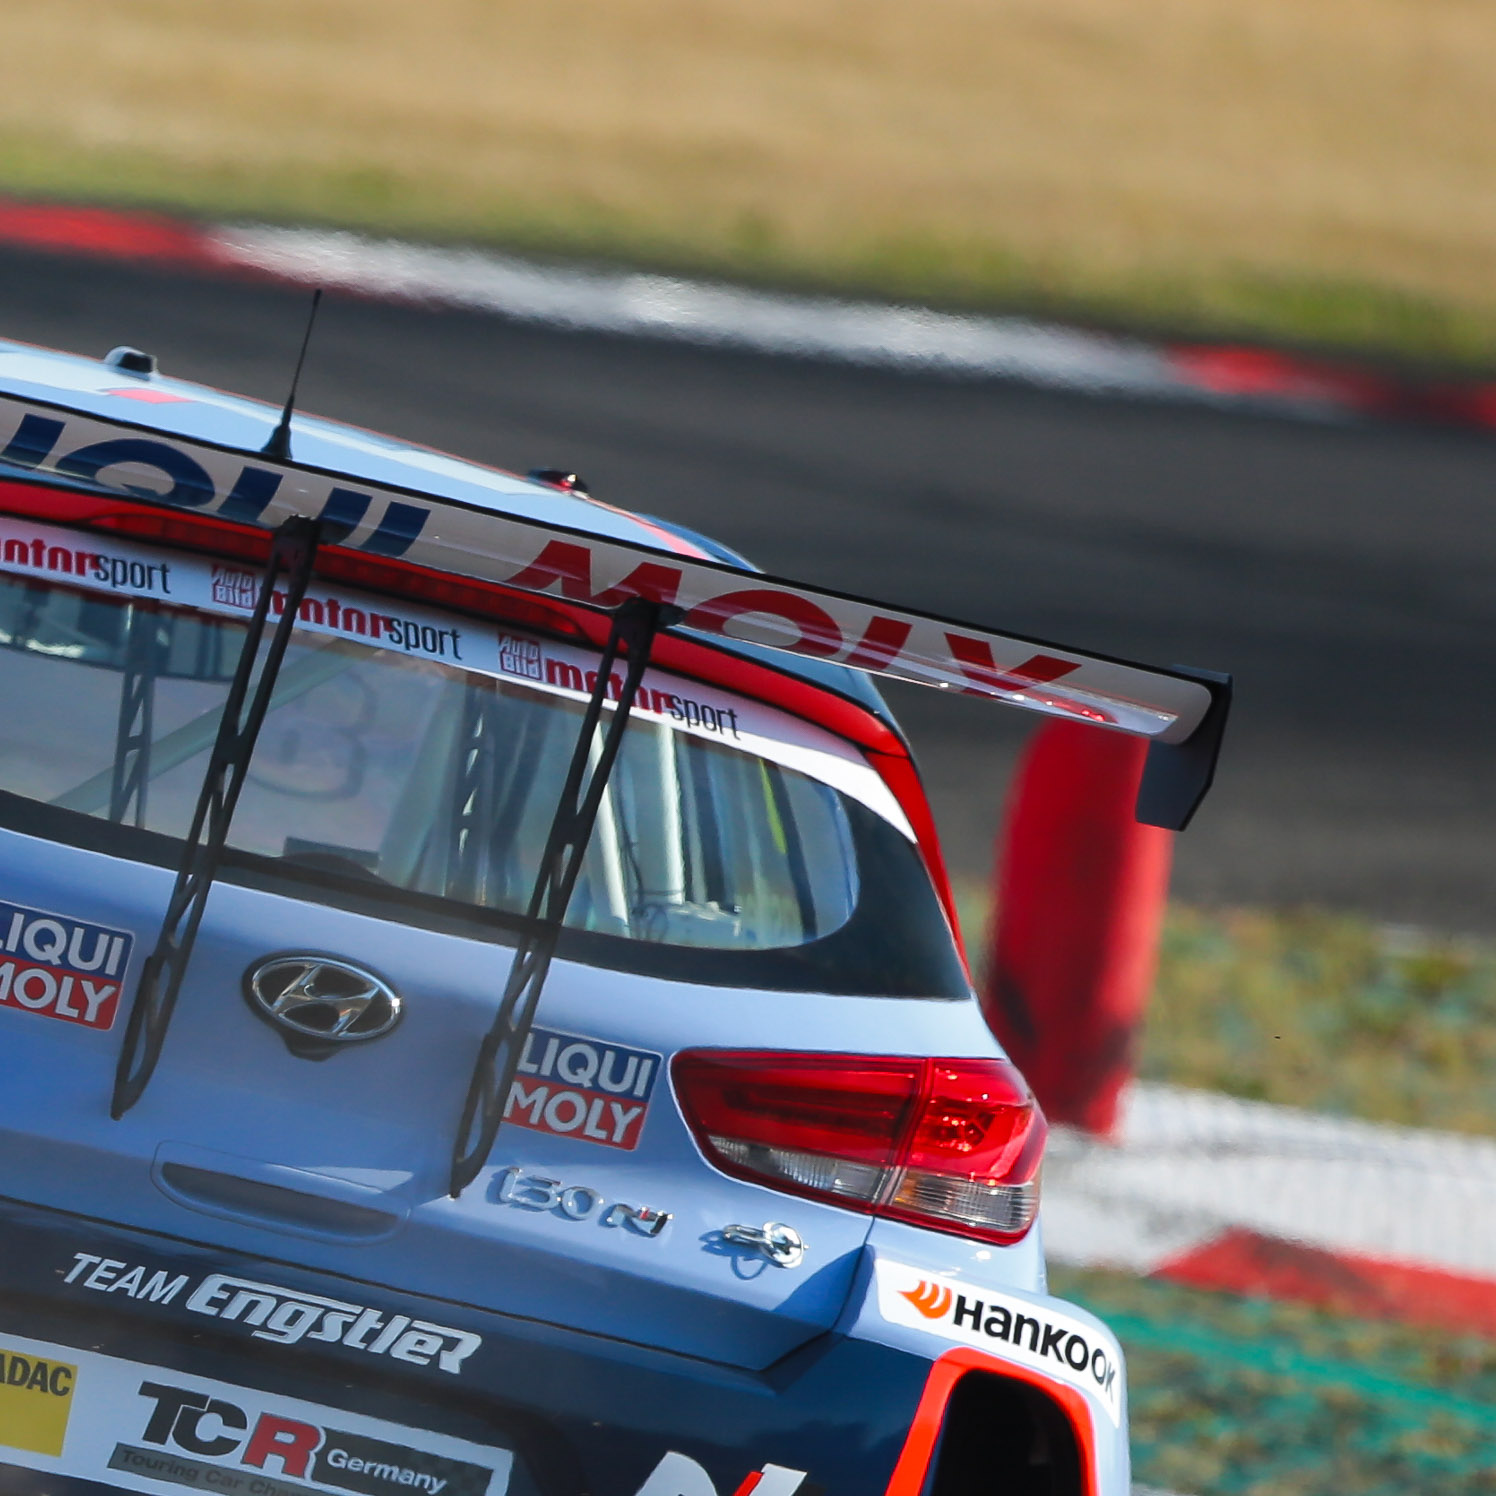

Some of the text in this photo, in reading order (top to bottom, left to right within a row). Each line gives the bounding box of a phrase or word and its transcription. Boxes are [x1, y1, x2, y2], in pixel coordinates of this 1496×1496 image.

[519, 1031, 655, 1098] LIQUI
[508, 1079, 644, 1146] MOLY
[63, 1251, 484, 1375] TEAM Engstler
[121, 1450, 200, 1483] Touring
[203, 1469, 241, 1490] Car
[137, 1380, 448, 1494] TCR Germany
